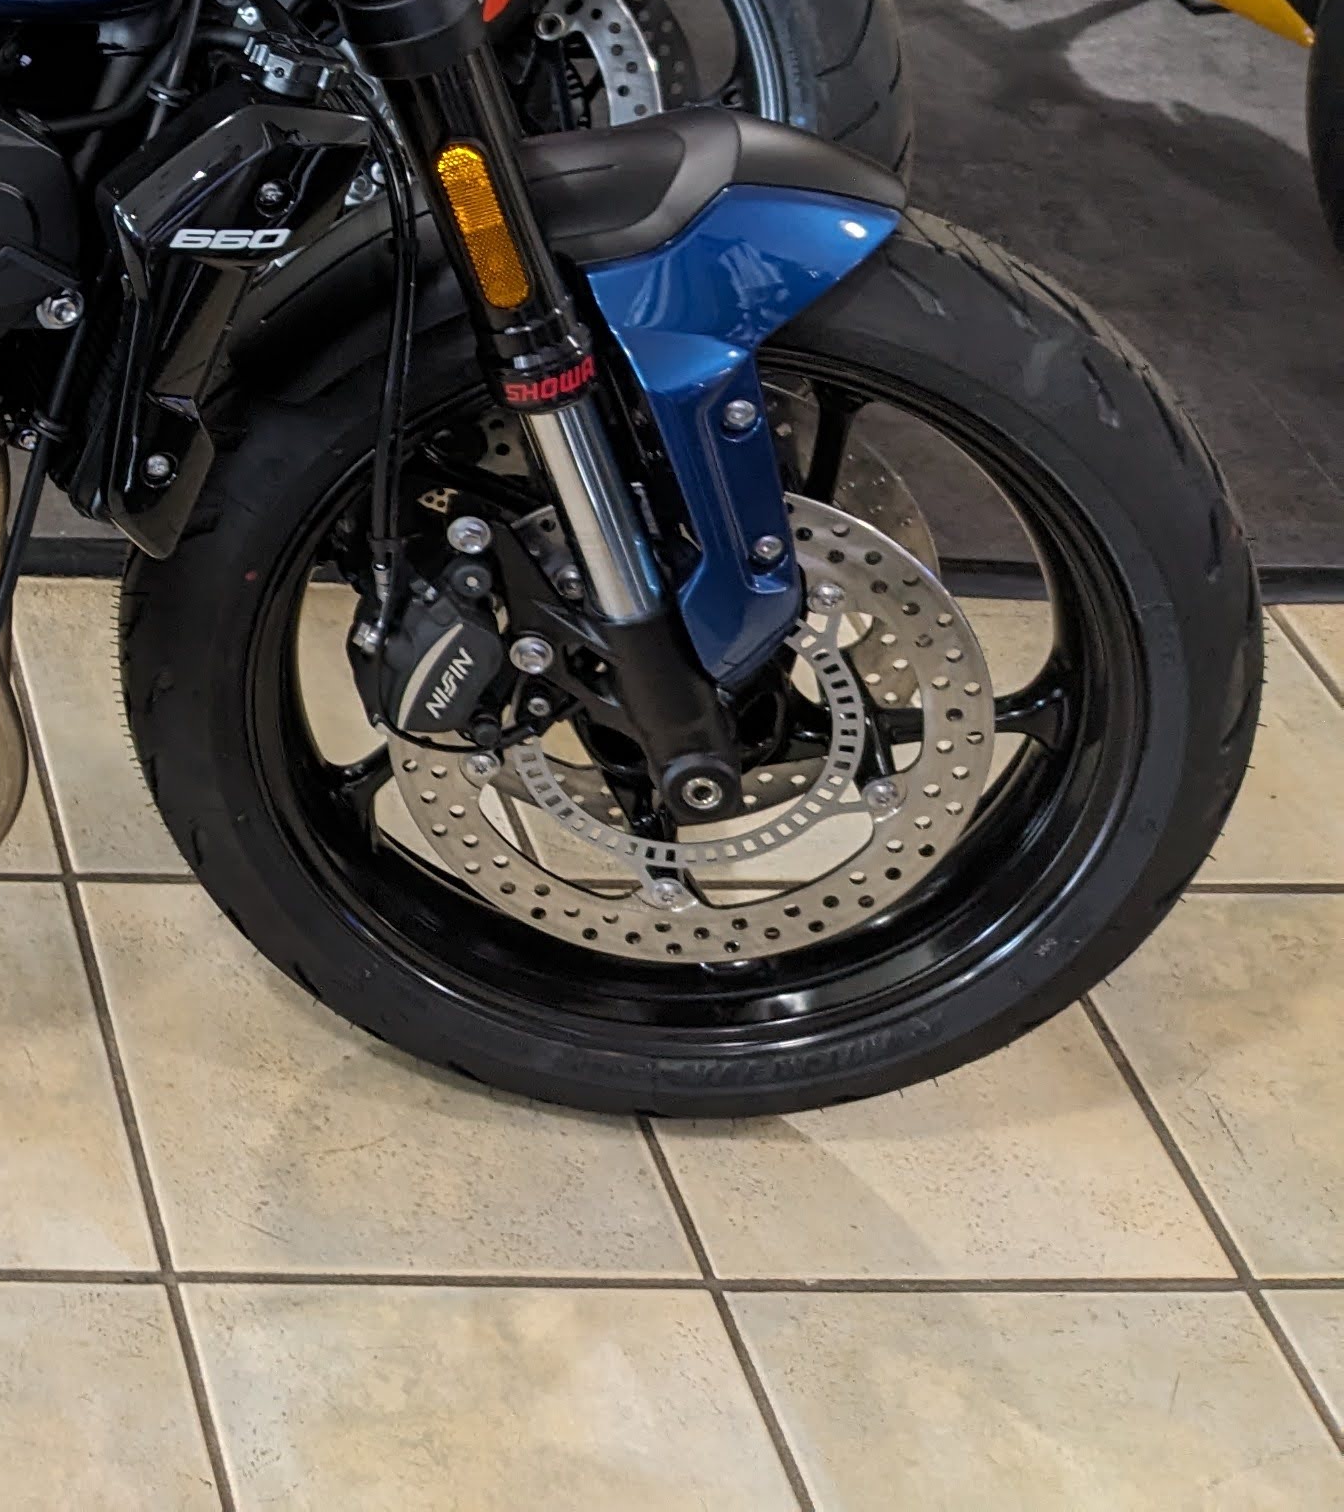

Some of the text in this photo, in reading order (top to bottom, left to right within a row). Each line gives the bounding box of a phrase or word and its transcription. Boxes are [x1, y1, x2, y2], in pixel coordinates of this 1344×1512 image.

[169, 228, 292, 250] 660
[505, 355, 596, 402] SHOWA
[425, 647, 474, 720] NISSIN
